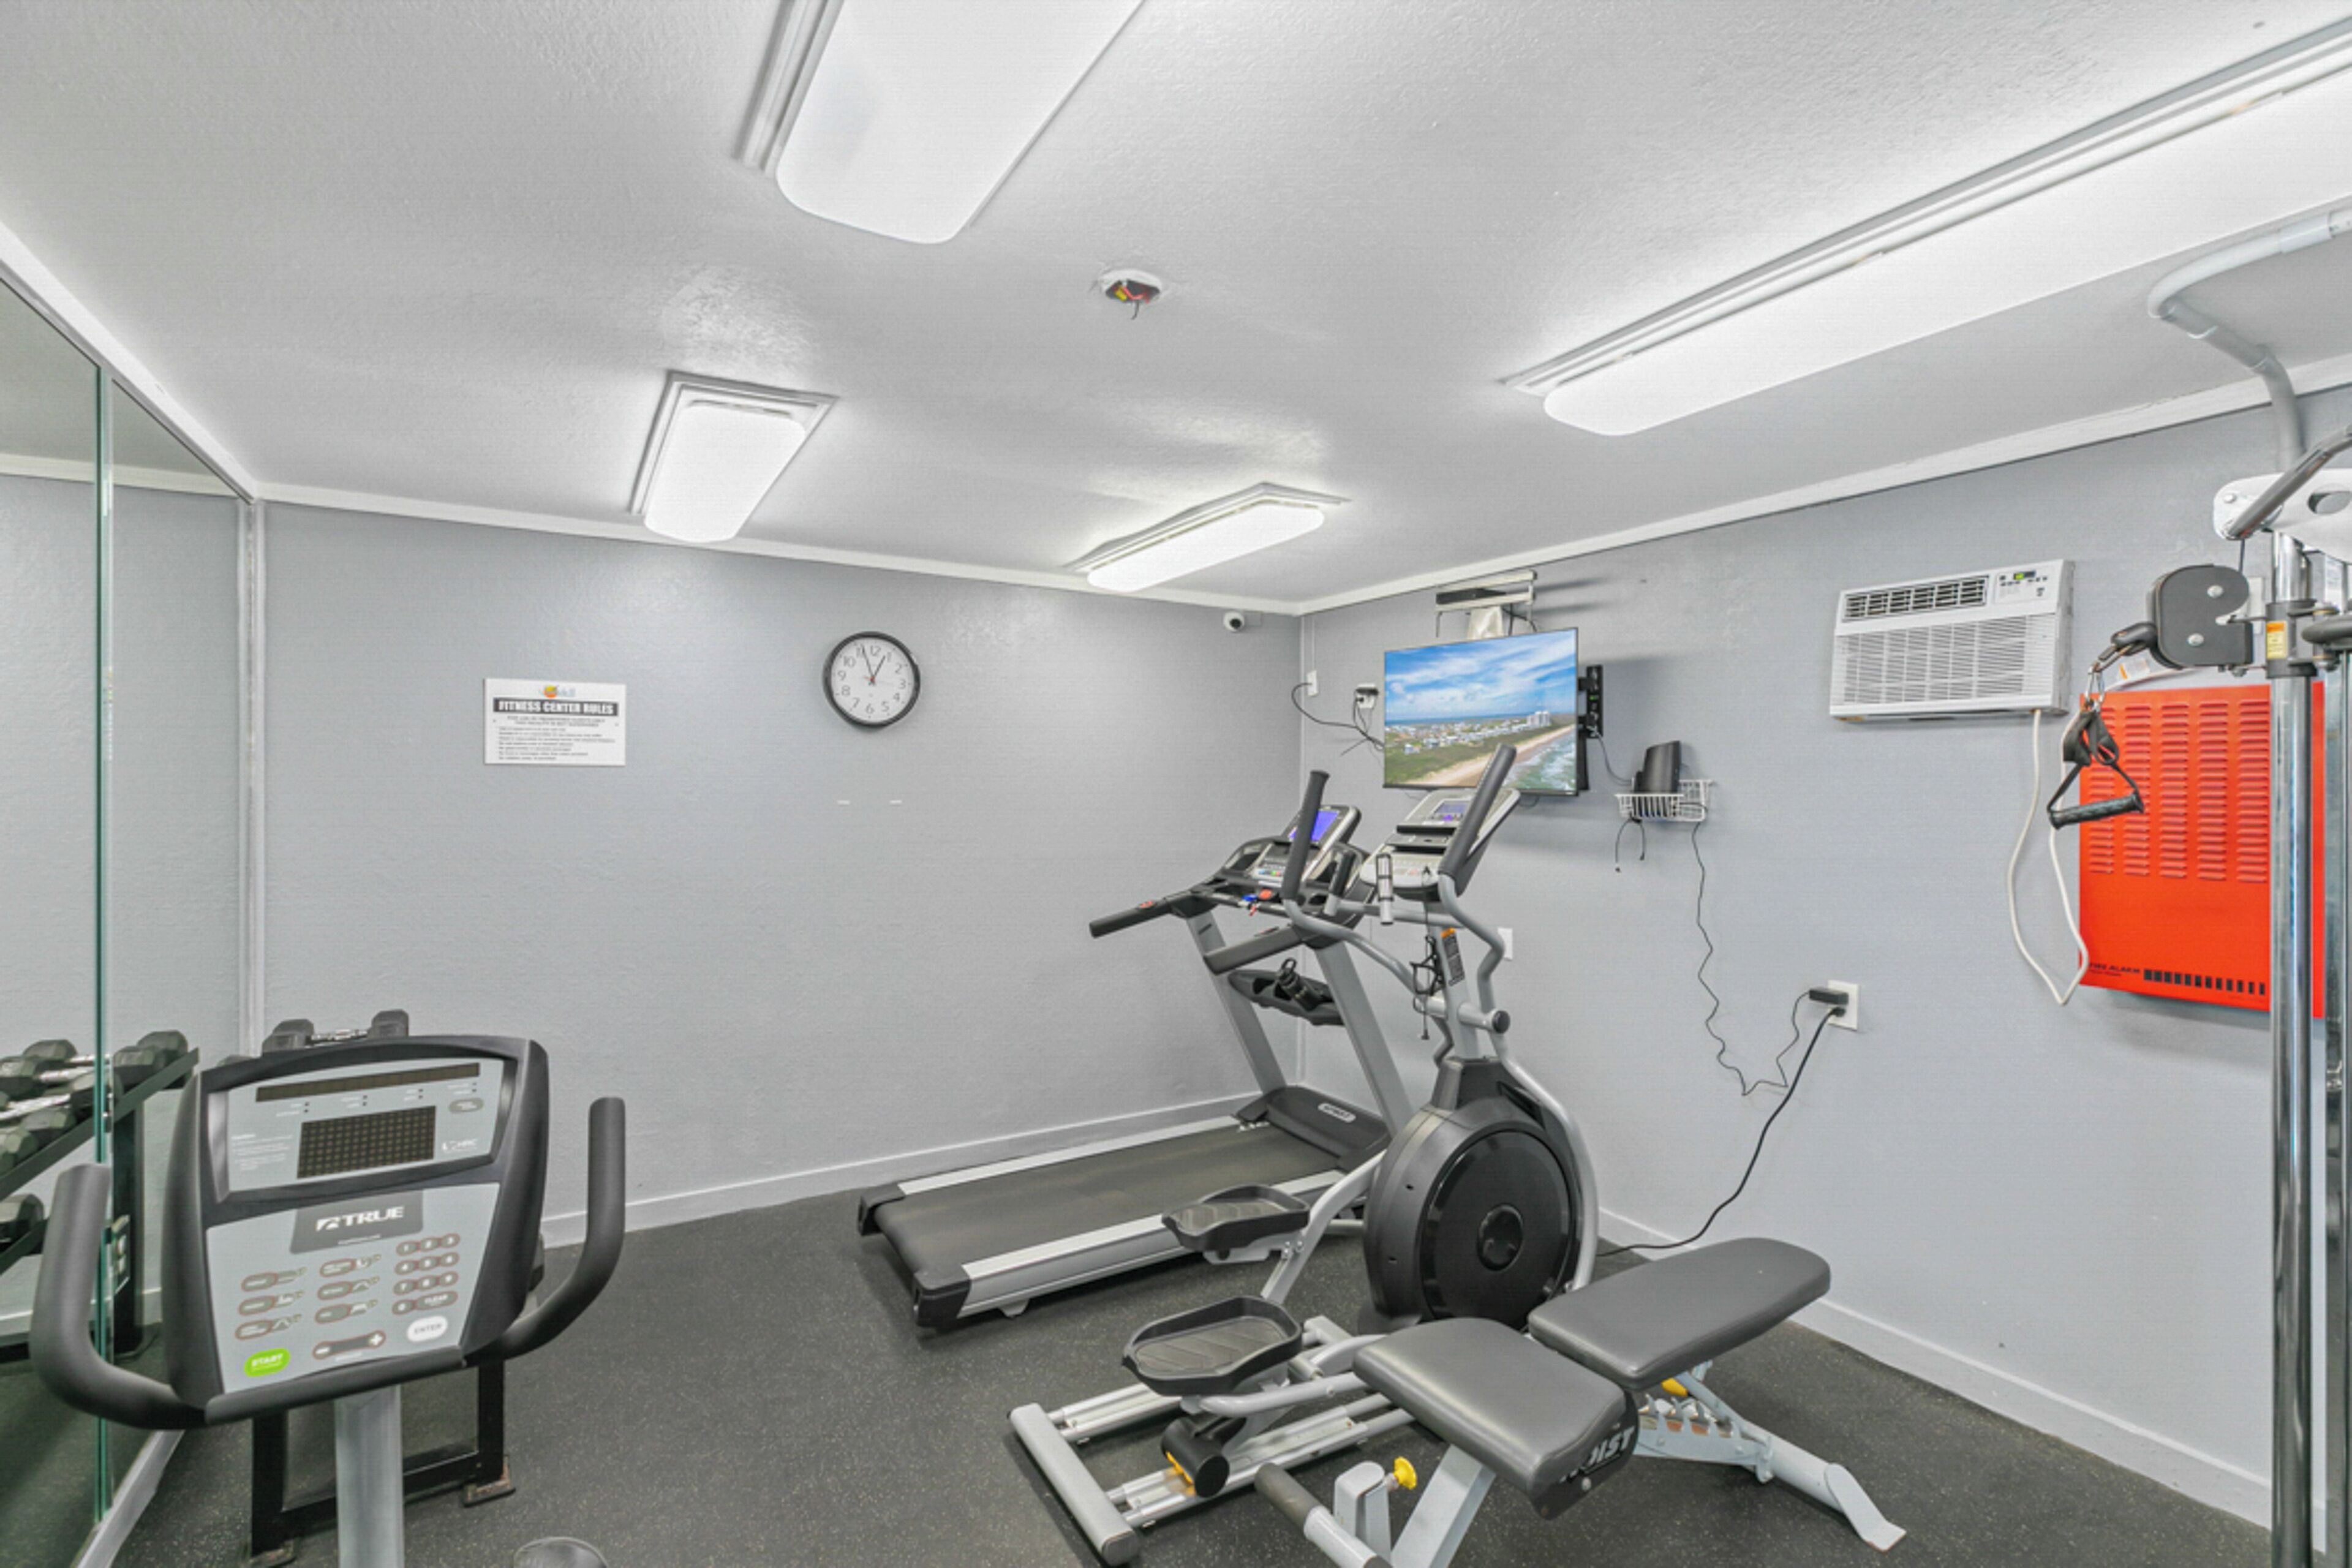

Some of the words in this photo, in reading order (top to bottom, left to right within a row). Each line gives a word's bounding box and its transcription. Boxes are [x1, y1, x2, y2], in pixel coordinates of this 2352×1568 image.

[870, 645, 881, 656] 12
[843, 656, 856, 667] 10
[887, 652, 892, 662] 1
[895, 664, 902, 674] 2
[837, 671, 846, 680] 9
[899, 679, 906, 690] 3
[841, 685, 851, 696] 8
[852, 697, 861, 709] 7
[892, 693, 900, 702] 4
[498, 700, 541, 711] FITNESS
[543, 701, 581, 712] CENTER
[583, 703, 613, 715] RULES
[865, 703, 874, 714] 6
[881, 701, 889, 712] 5
[342, 1205, 405, 1227] TRUE
[414, 1323, 442, 1335] ENTER
[251, 1353, 284, 1367] START
